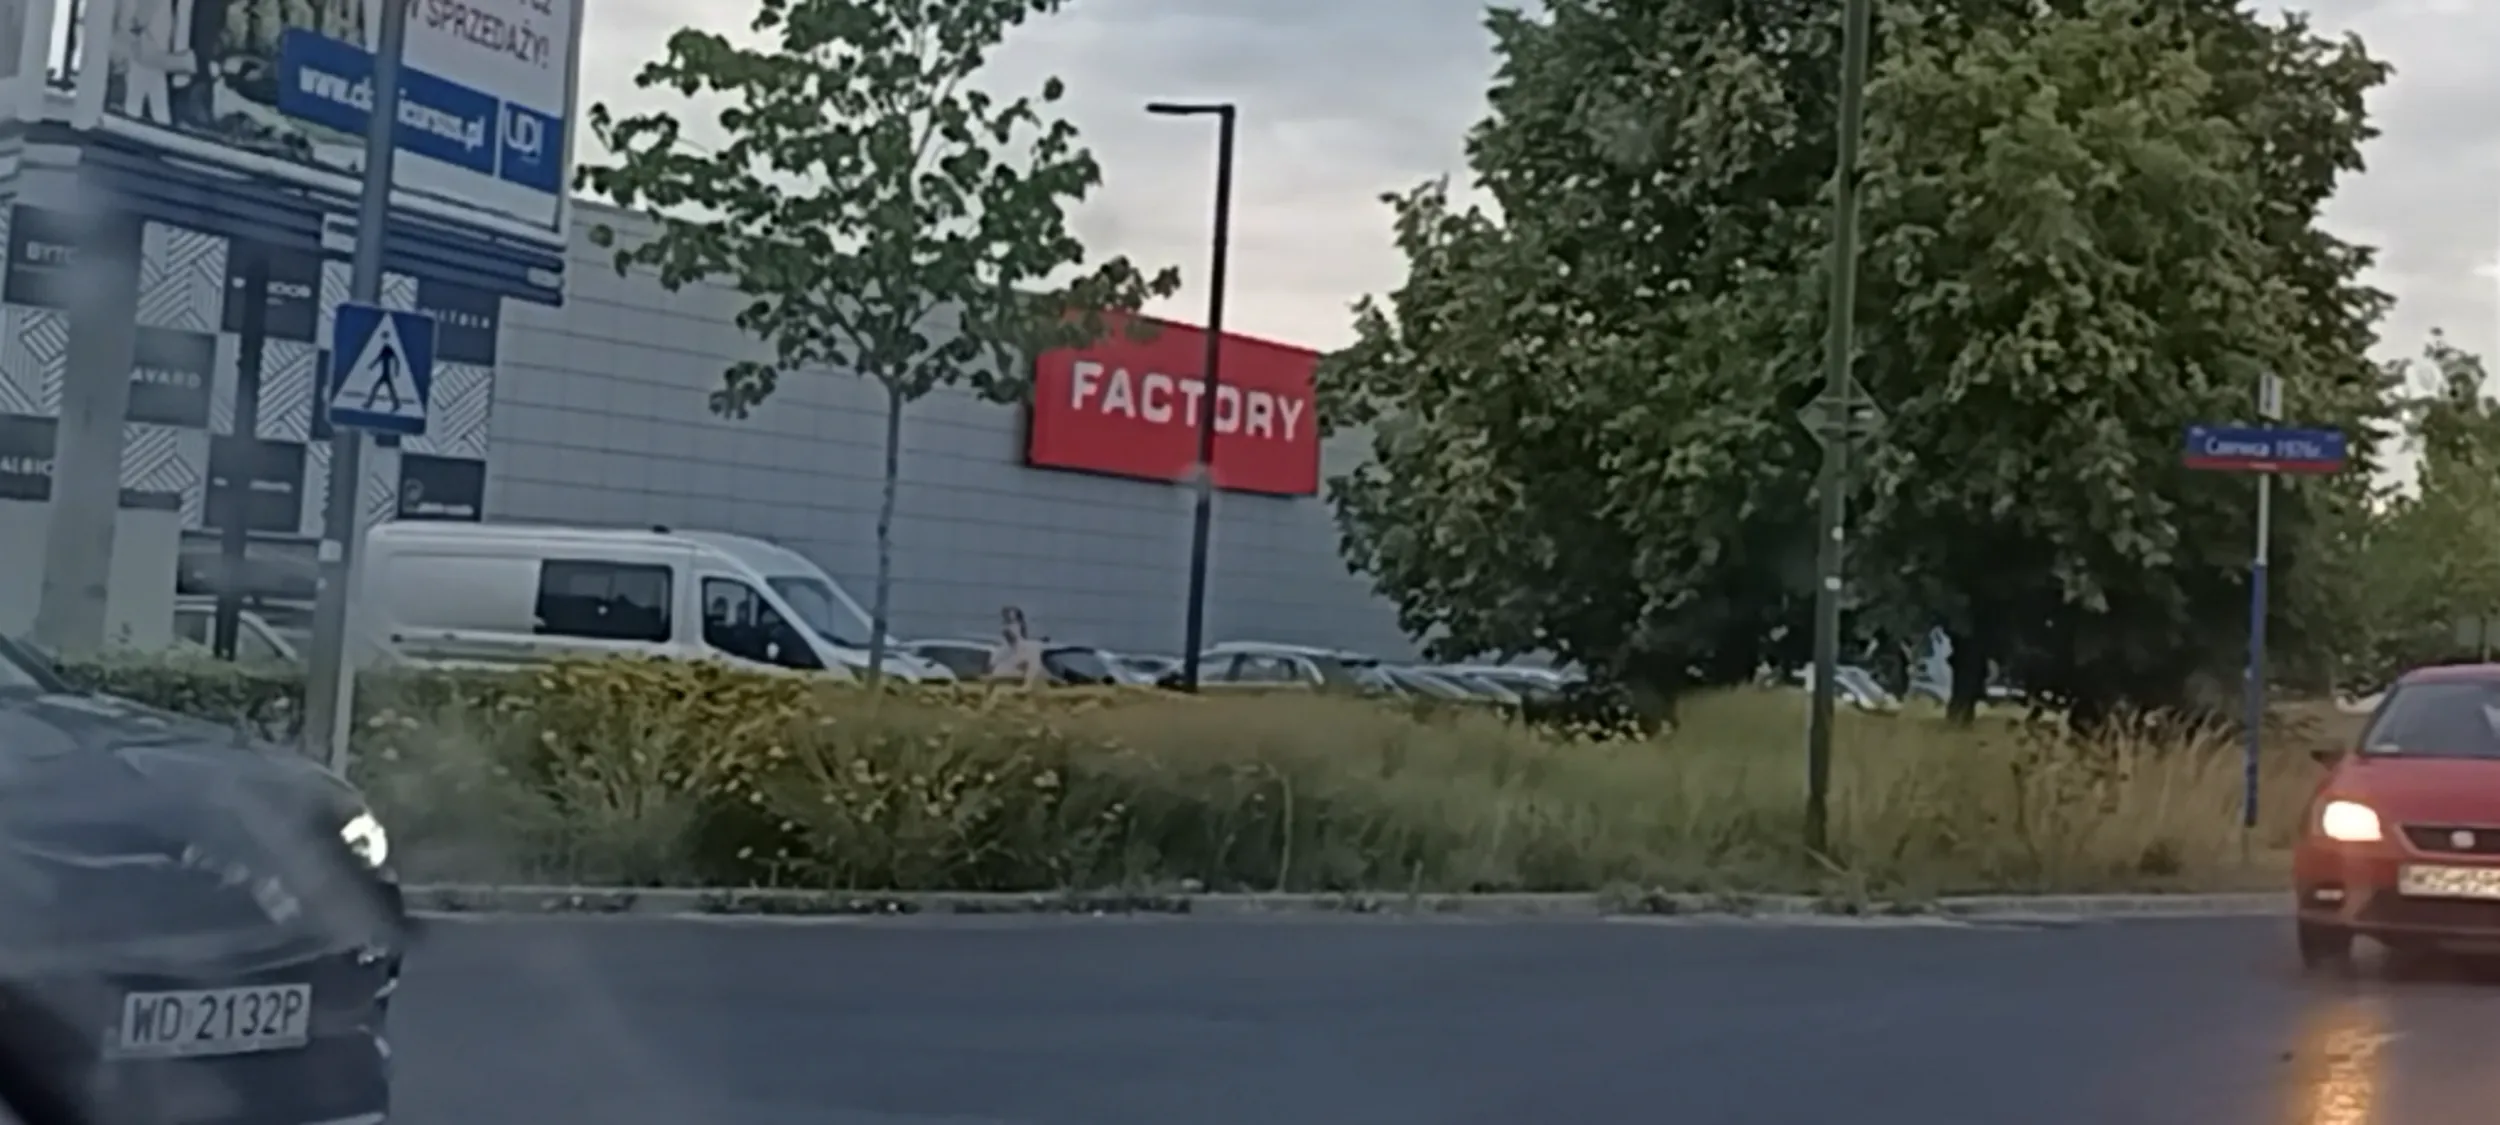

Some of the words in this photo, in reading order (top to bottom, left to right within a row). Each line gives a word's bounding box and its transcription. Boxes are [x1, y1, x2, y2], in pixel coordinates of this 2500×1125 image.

[1070, 360, 1304, 442] FACTORY
[132, 997, 183, 1042] WD
[195, 989, 303, 1040] 2132P
